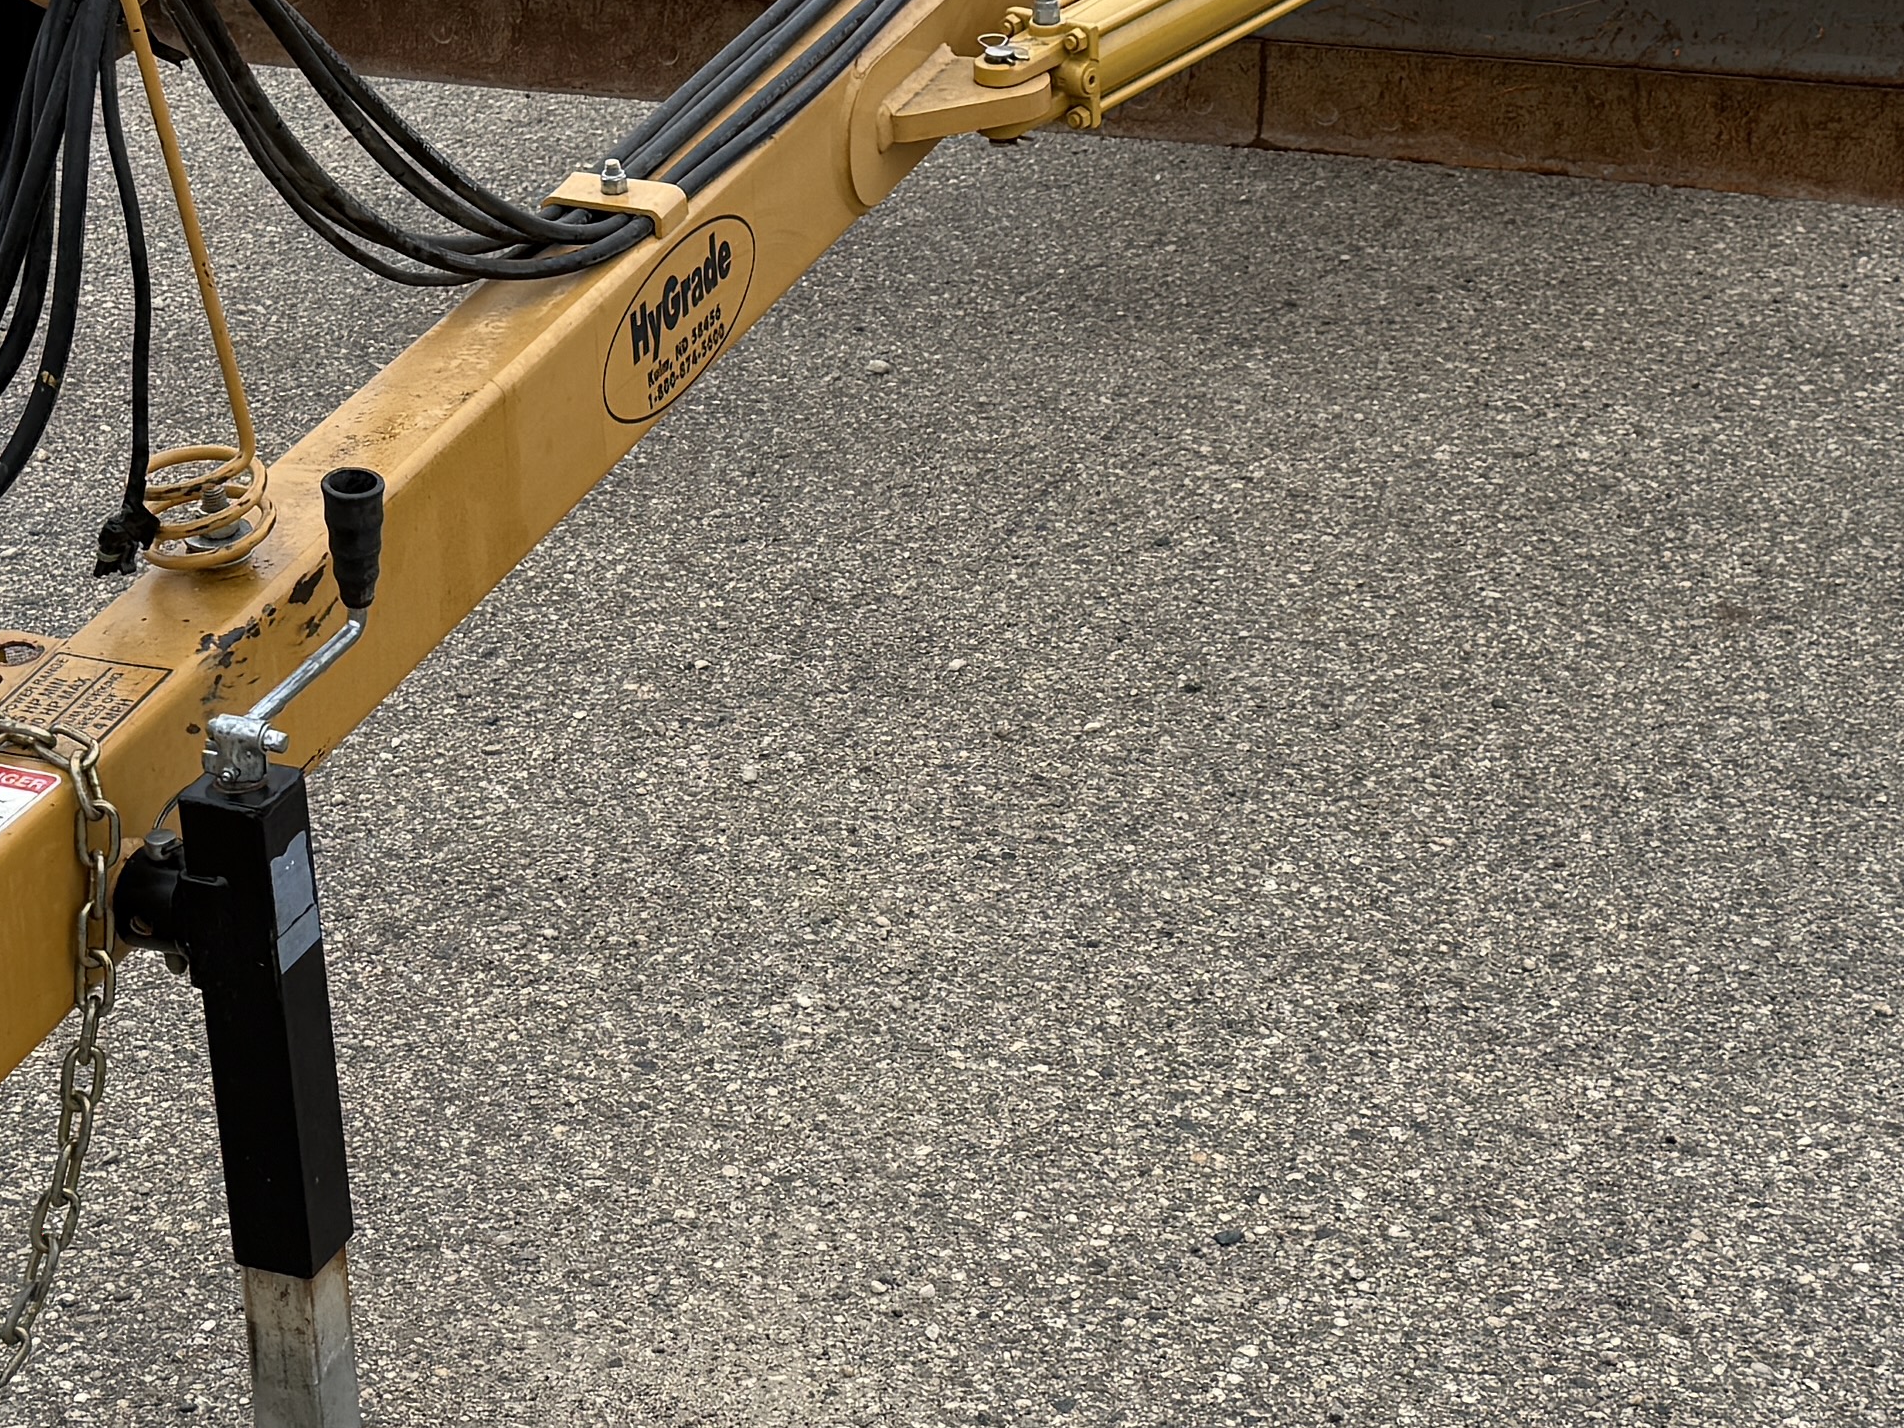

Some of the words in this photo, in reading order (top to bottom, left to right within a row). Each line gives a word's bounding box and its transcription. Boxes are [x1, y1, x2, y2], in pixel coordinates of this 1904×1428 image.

[629, 231, 732, 366] HyGrade
[23, 696, 42, 714] HP
[40, 700, 63, 717] HP
